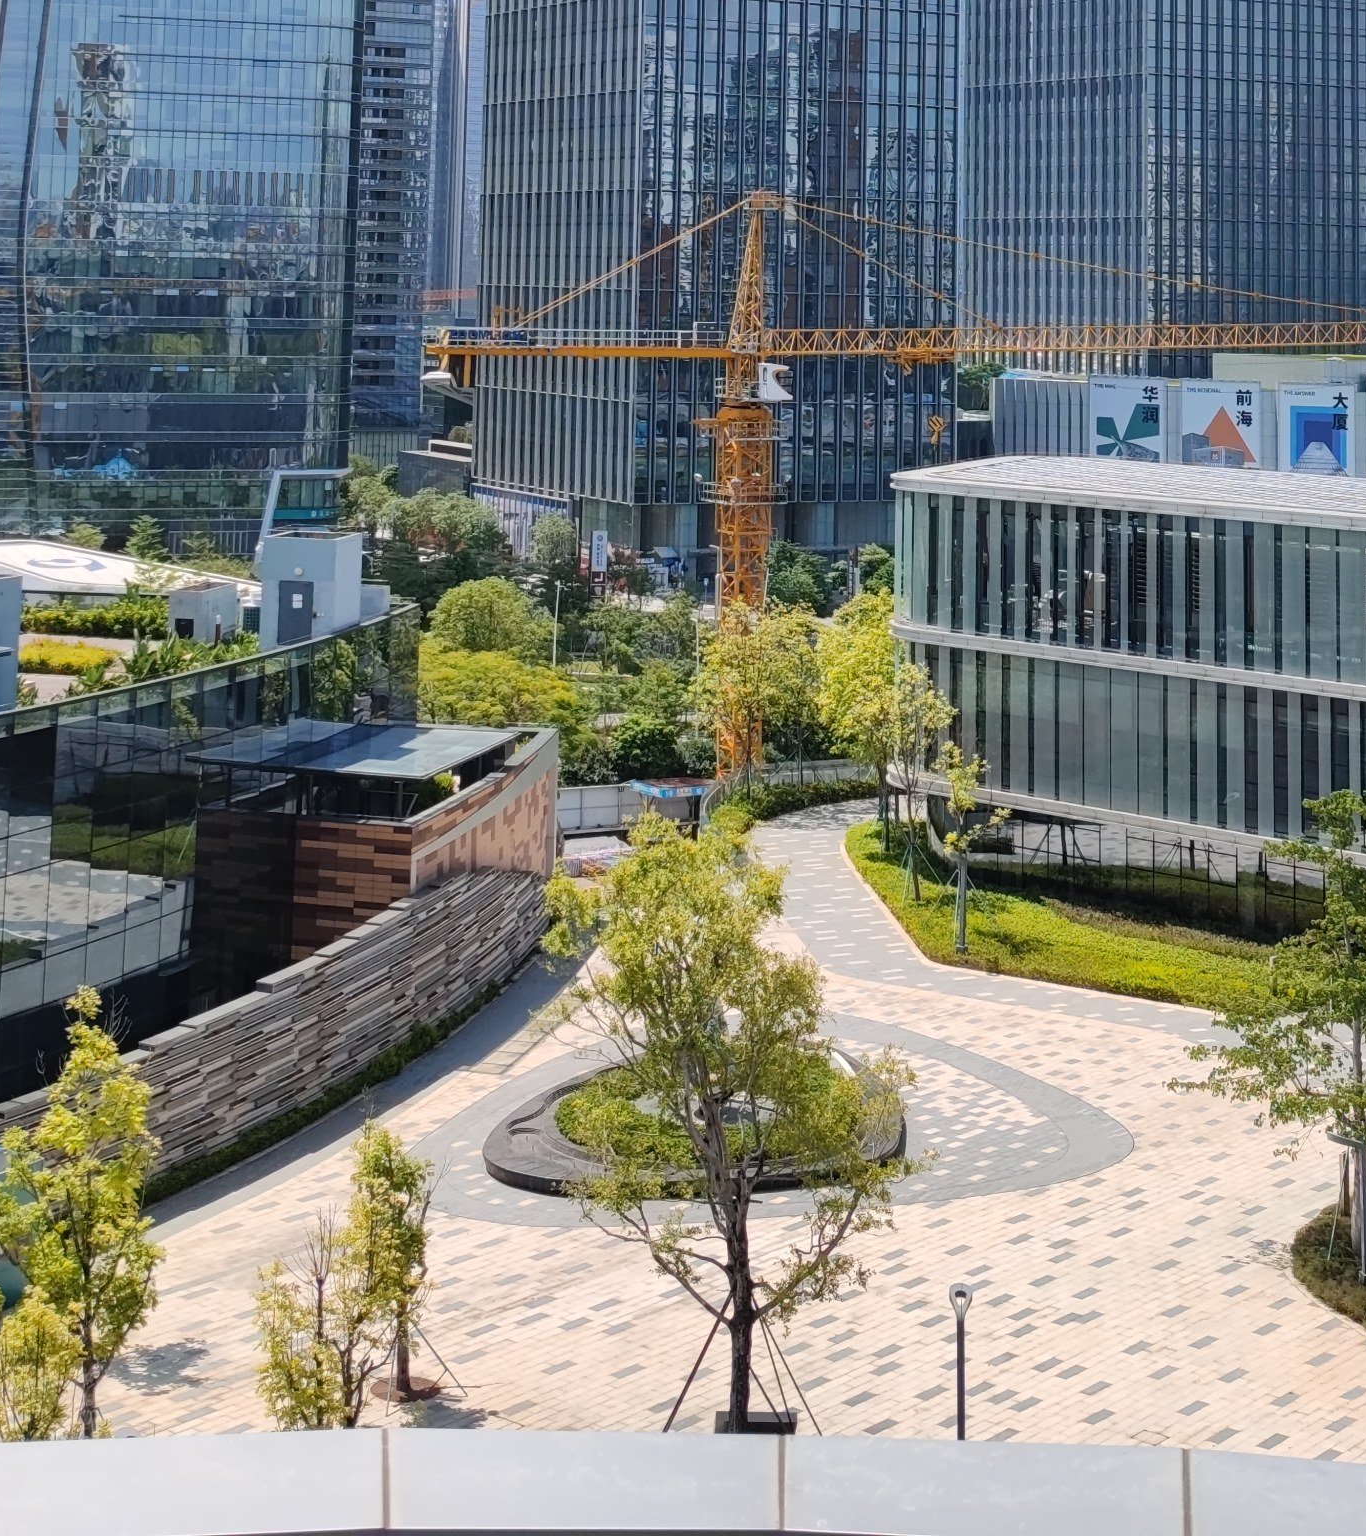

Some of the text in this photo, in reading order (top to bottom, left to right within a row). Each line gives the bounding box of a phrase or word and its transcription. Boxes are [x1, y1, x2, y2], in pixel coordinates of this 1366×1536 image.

[1141, 385, 1160, 424] 华润
[1236, 389, 1253, 428] 前海
[1332, 392, 1350, 431] 大厦
